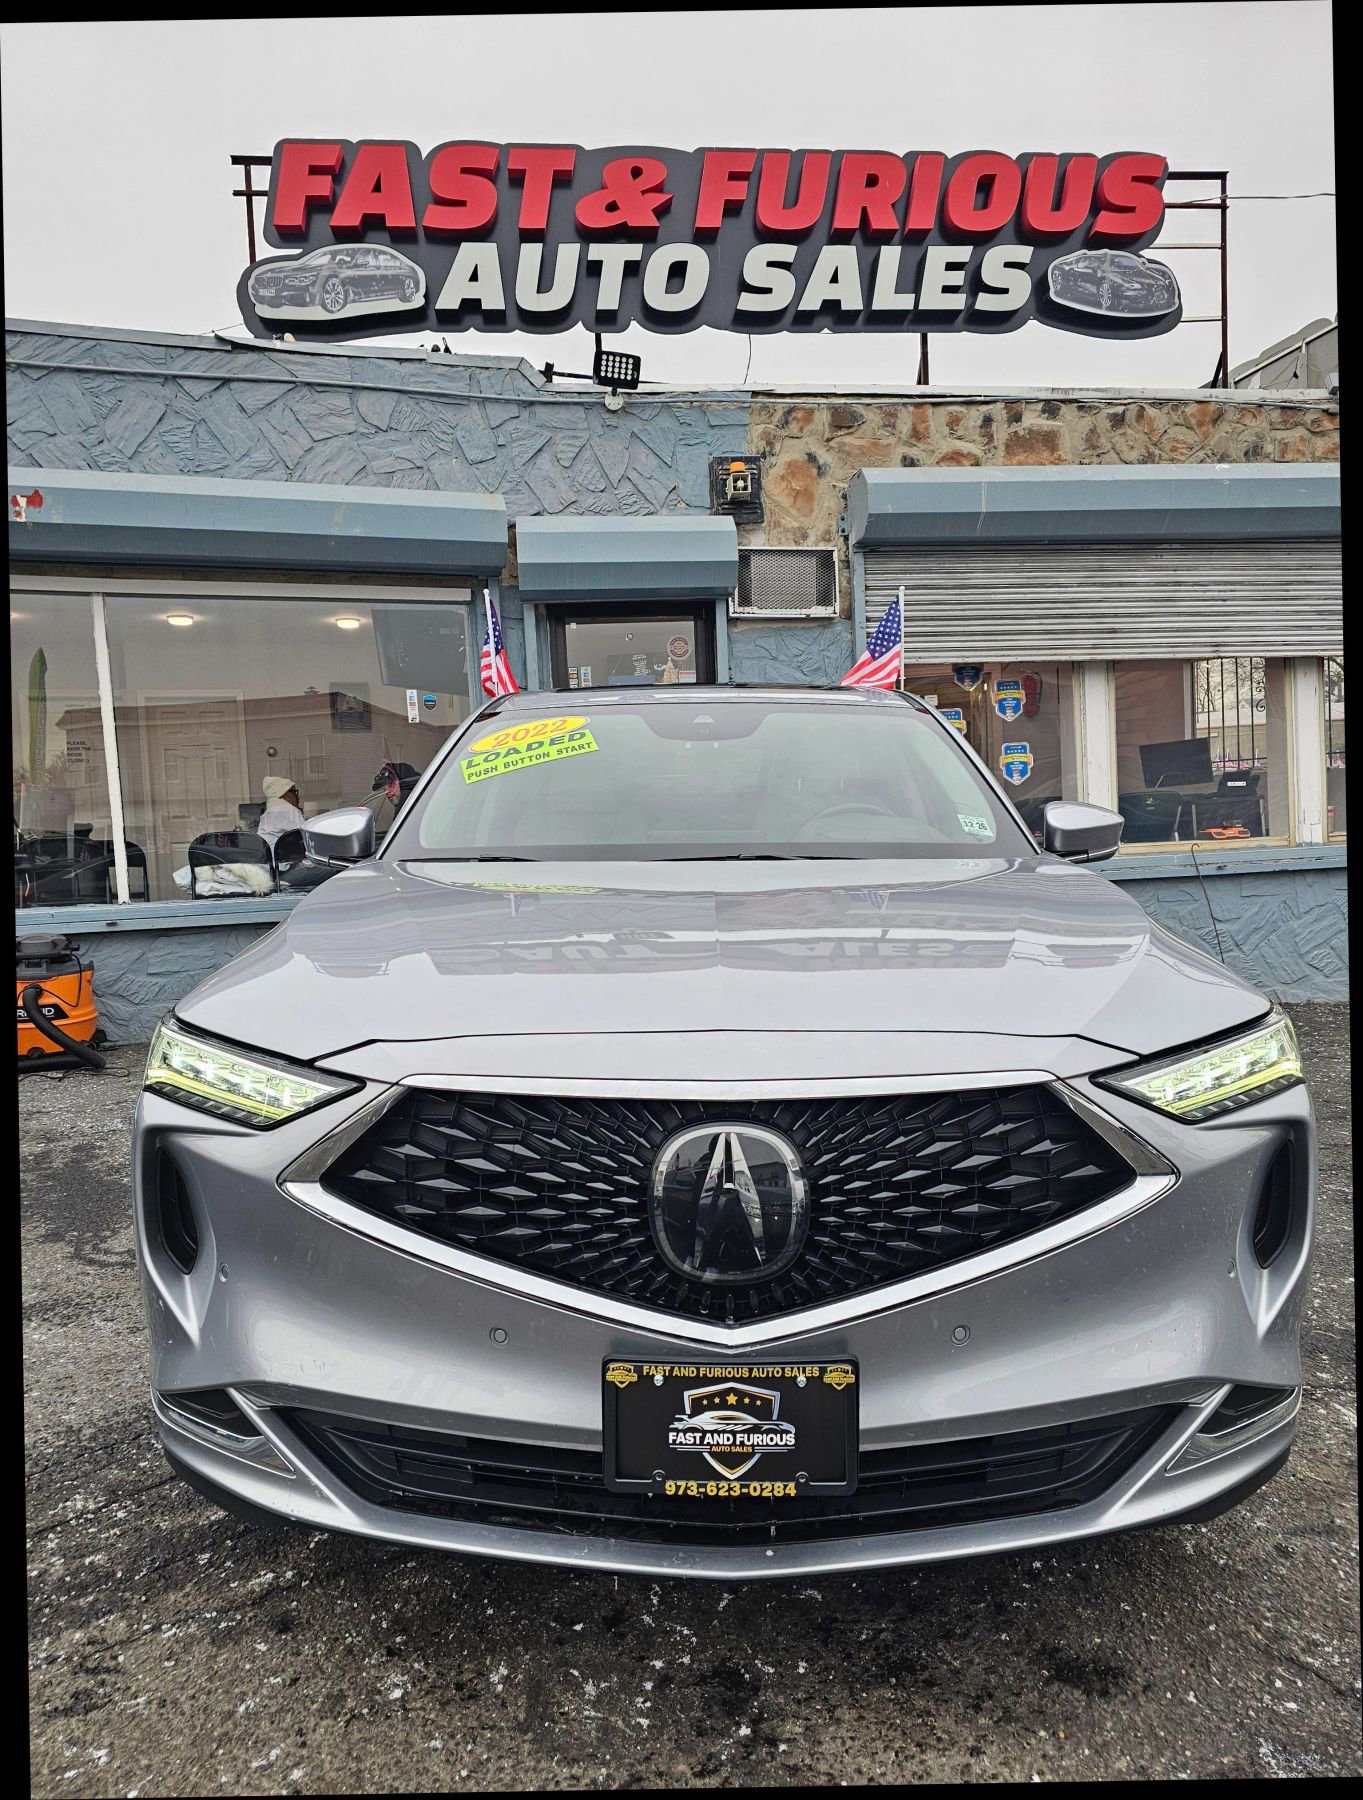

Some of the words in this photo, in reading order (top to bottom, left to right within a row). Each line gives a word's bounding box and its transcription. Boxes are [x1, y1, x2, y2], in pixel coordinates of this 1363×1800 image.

[272, 142, 576, 235] FAST
[575, 156, 674, 236] &
[693, 150, 1168, 238] FURIOUS
[434, 242, 710, 313] AUTO
[736, 244, 1034, 313] SALES
[490, 719, 568, 749] 2022
[465, 731, 587, 770] LOADED
[467, 765, 498, 781] PUSH
[503, 751, 550, 770] BUTTON
[556, 742, 593, 756] START
[963, 820, 976, 828] 12
[642, 1365, 671, 1378] FAST
[673, 1366, 697, 1378] AND
[700, 1366, 749, 1378] FURIOUS
[751, 1366, 782, 1379] AUTO
[785, 1366, 820, 1378] SALES
[668, 1431, 702, 1445] FAST
[704, 1432, 734, 1446] AND
[736, 1432, 796, 1446] FURIOUS
[664, 1480, 797, 1498] 973-623-0284
